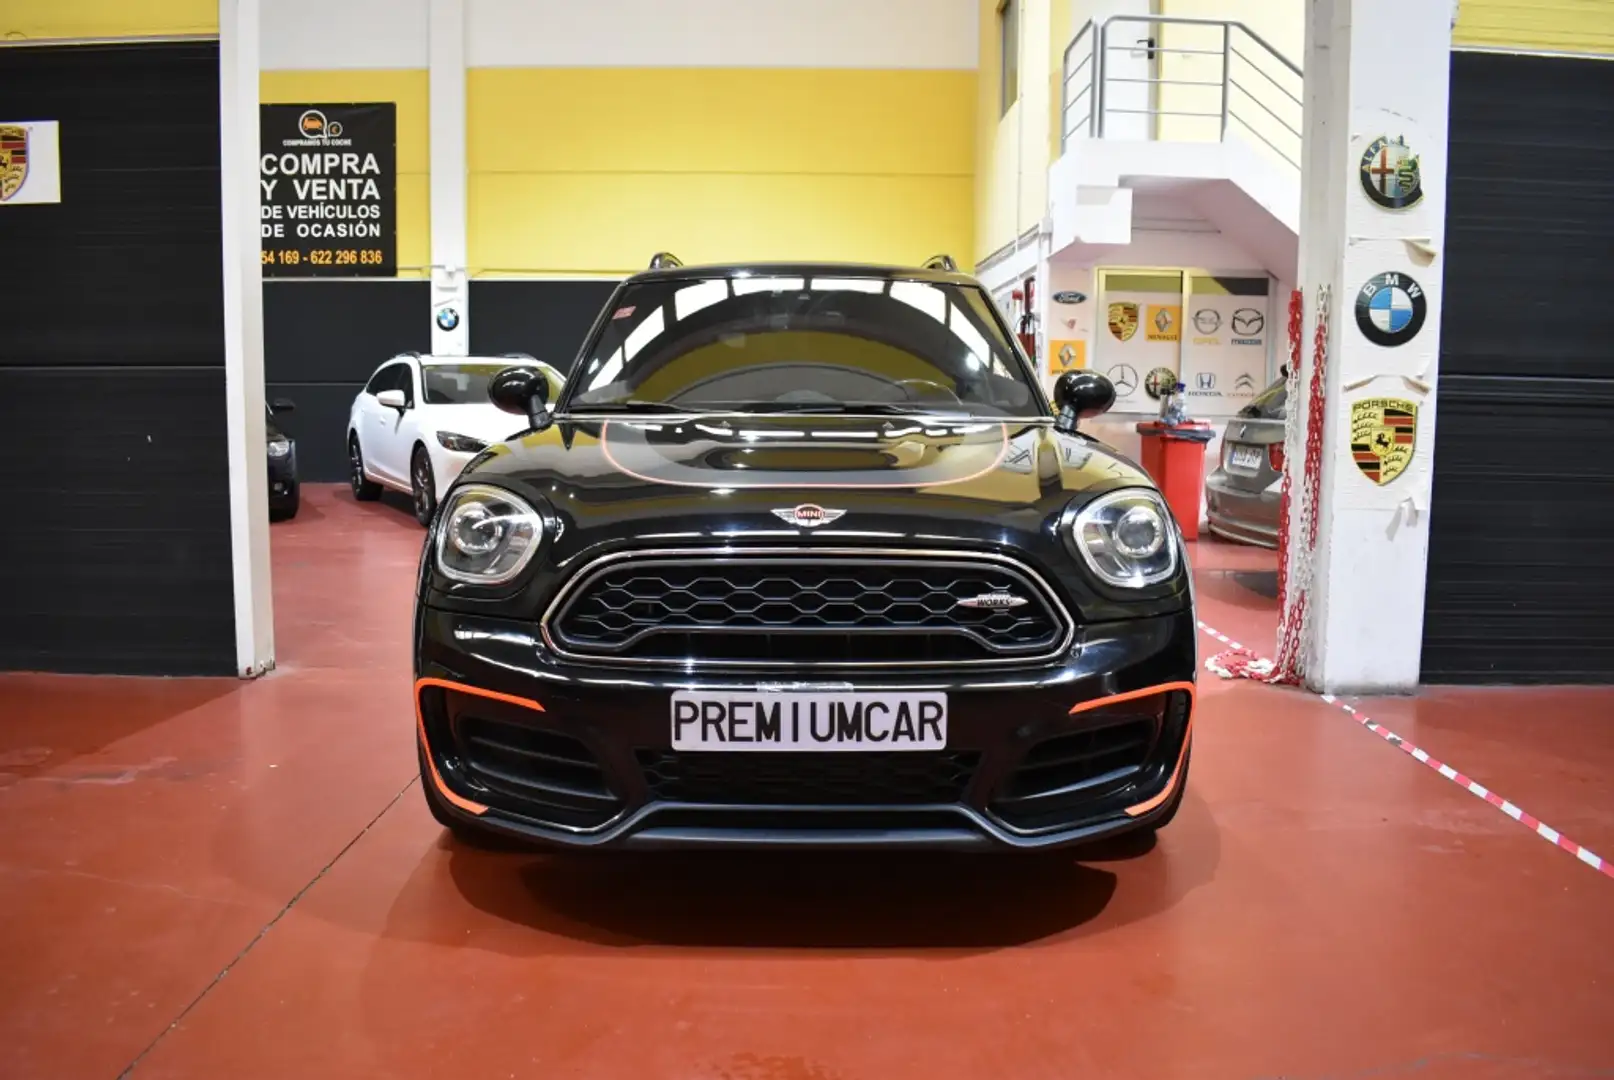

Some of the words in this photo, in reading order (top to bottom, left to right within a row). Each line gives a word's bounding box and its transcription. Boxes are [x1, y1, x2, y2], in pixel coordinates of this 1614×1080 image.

[261, 152, 381, 176] COMPRA
[261, 179, 278, 201] Y
[293, 178, 381, 200] VENTA
[261, 205, 282, 219] DE
[287, 202, 381, 219] VEHÍCULOS
[261, 224, 285, 238] DE
[296, 220, 381, 238] OCASIÓN
[279, 250, 300, 264] 169
[310, 250, 332, 264] 622
[335, 250, 358, 264] 296
[360, 250, 383, 264] 836
[1363, 273, 1422, 299] BMW
[1352, 399, 1414, 413] PORSCHE
[797, 510, 821, 519] MINI
[673, 700, 944, 743] PREMIUMCAR
